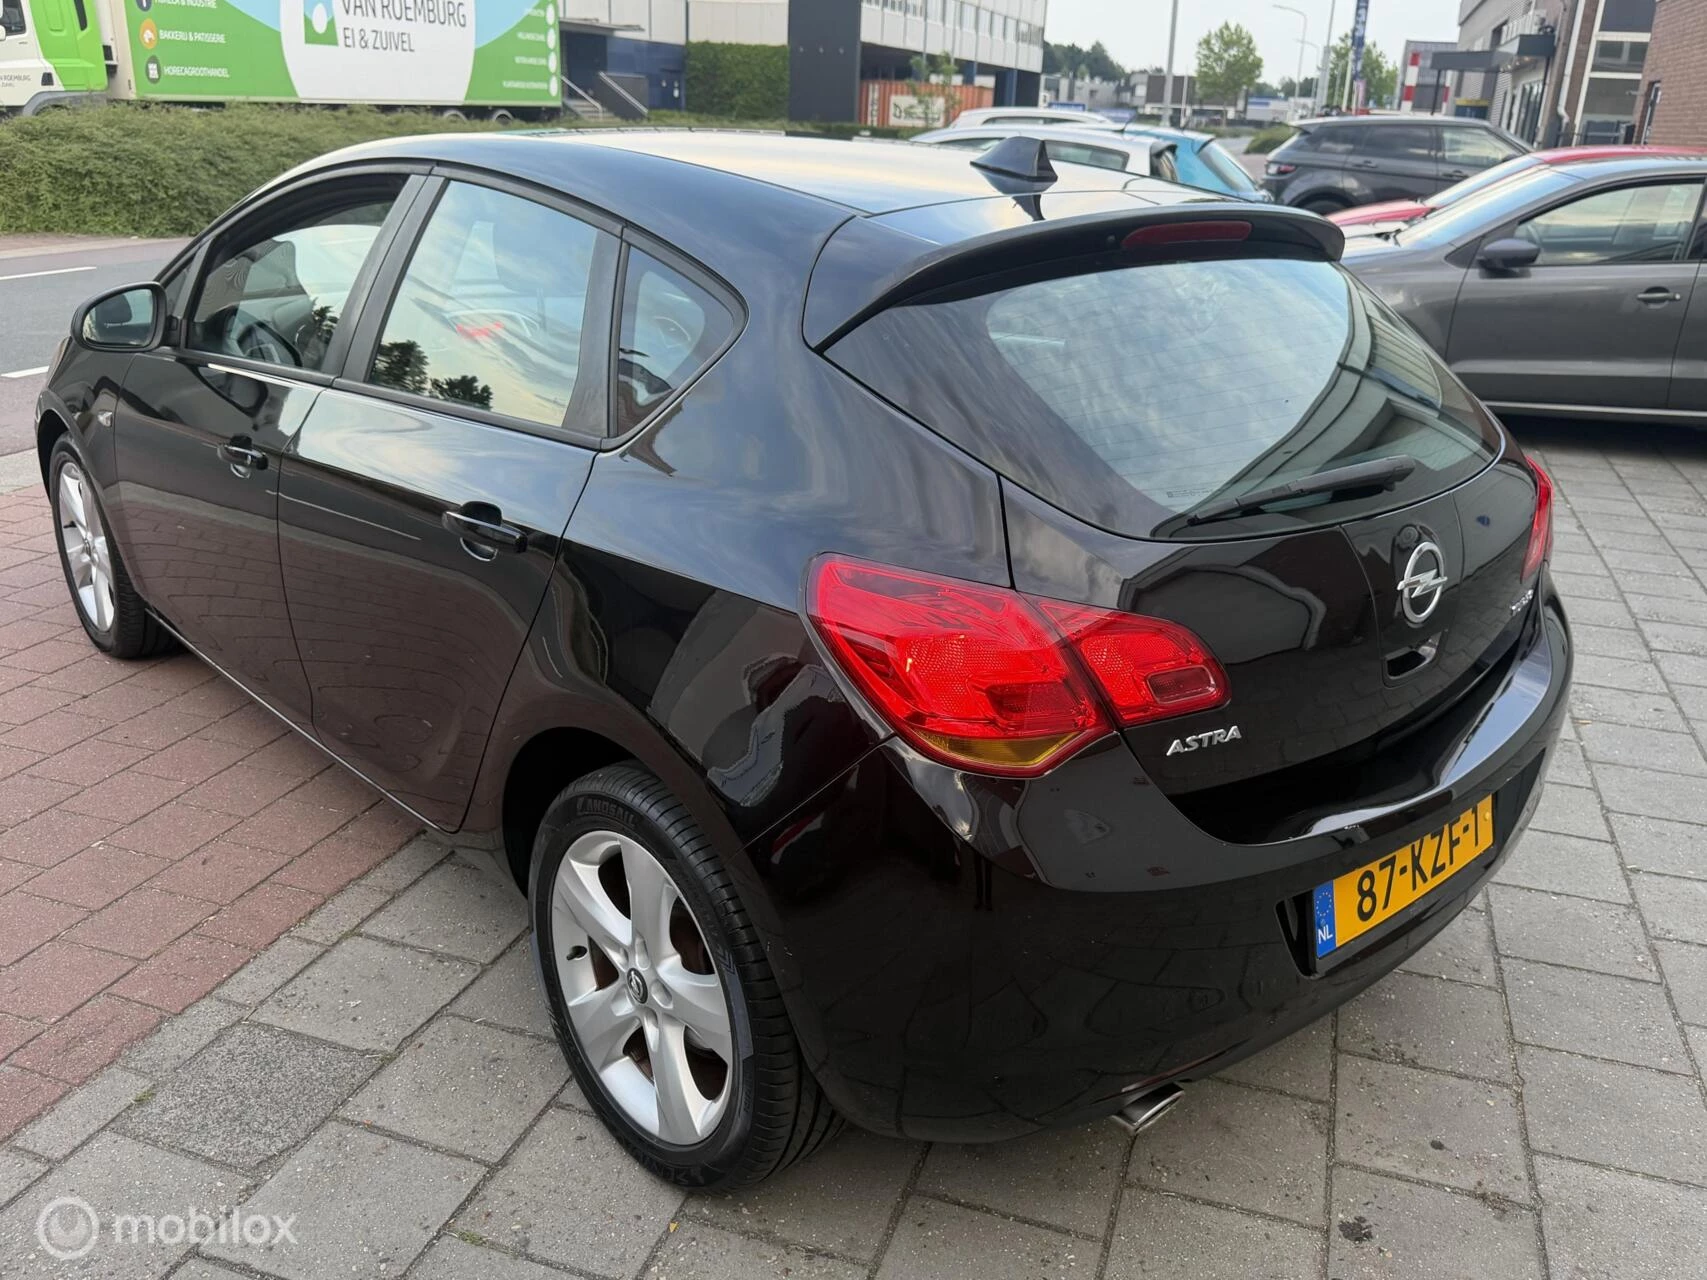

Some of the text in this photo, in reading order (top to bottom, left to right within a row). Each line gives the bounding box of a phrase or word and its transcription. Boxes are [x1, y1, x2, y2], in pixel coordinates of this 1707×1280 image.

[341, 0, 467, 28] VAN ROEMBURG
[343, 27, 415, 52] EI & ZUIVEL
[1166, 725, 1242, 756] ASTRA
[1356, 802, 1479, 922] 87-KZF-1
[1317, 924, 1334, 945] NL
